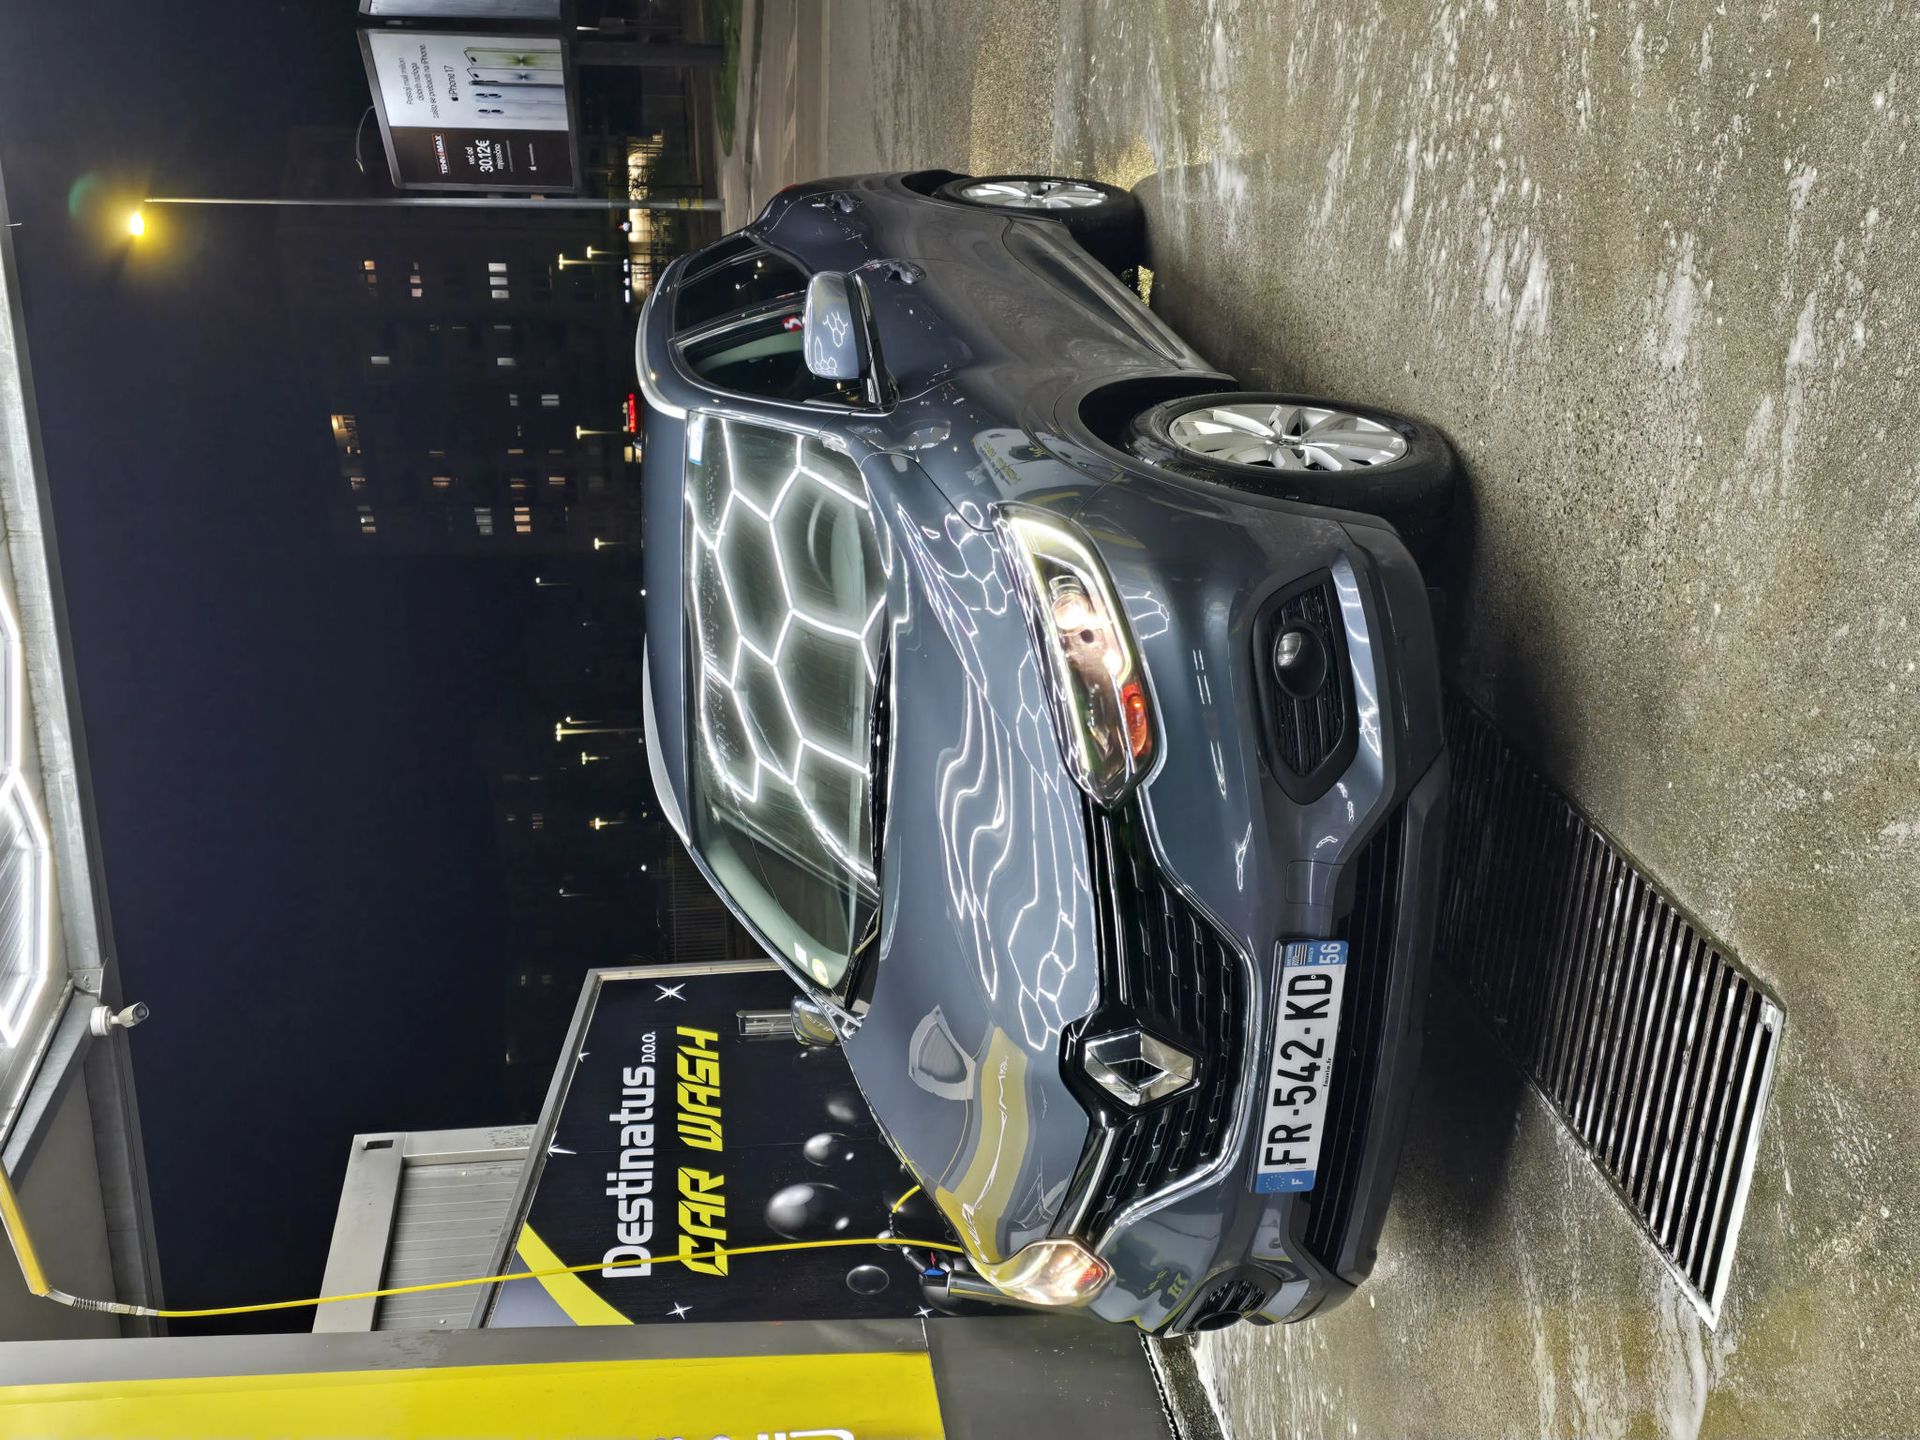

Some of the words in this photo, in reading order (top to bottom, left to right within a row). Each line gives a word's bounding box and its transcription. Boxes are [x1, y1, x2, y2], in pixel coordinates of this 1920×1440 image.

[444, 64, 454, 72] 17
[446, 72, 458, 96] iPhone
[430, 96, 437, 104] se
[465, 146, 474, 154] od
[476, 140, 494, 172] 30.12€
[1319, 943, 1341, 964] 56
[676, 1026, 722, 1152] WASH
[602, 1066, 655, 1278] Destinatus
[678, 1167, 728, 1277] CAR
